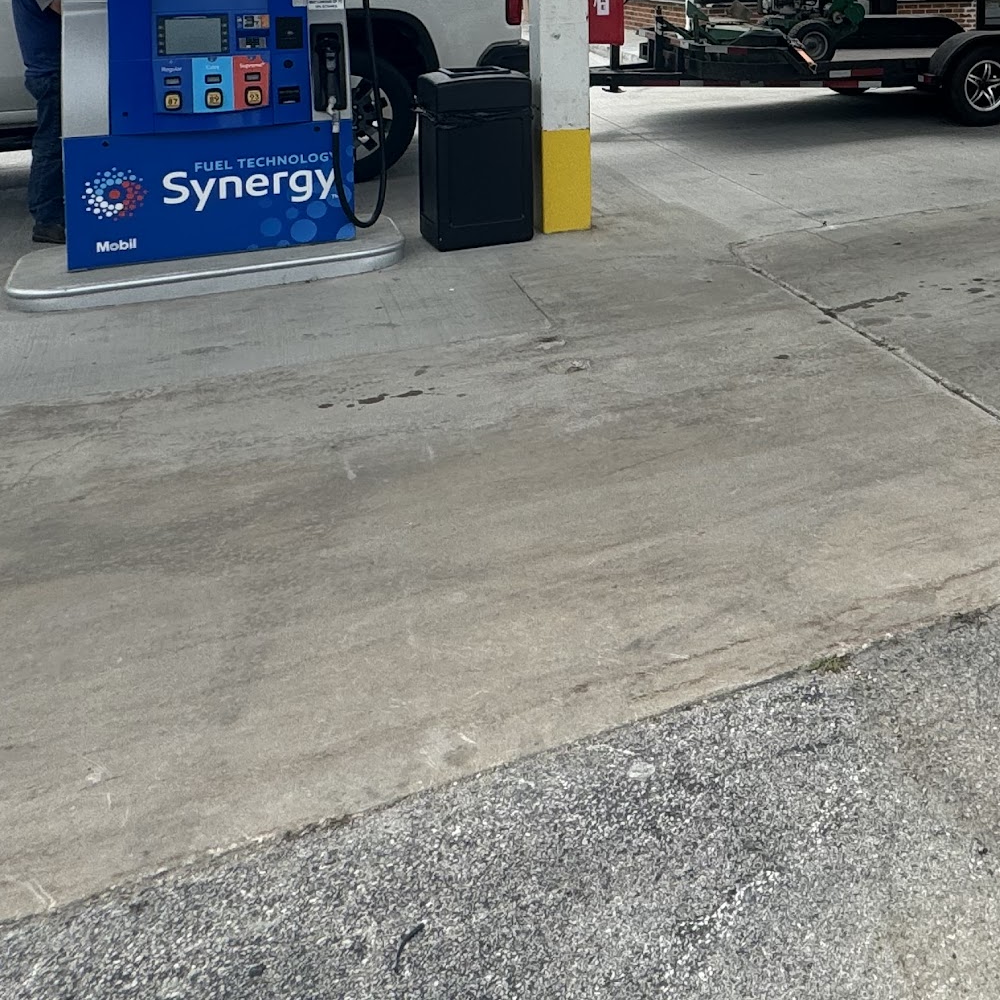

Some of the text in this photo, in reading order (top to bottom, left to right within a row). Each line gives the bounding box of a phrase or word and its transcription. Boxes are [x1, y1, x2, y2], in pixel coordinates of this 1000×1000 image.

[161, 66, 183, 74] Regular
[168, 97, 178, 105] 87
[249, 93, 259, 102] 93
[194, 151, 333, 173] FUEL TECHNOLOG
[162, 166, 335, 212] Synergy
[96, 238, 137, 253] Mobil
